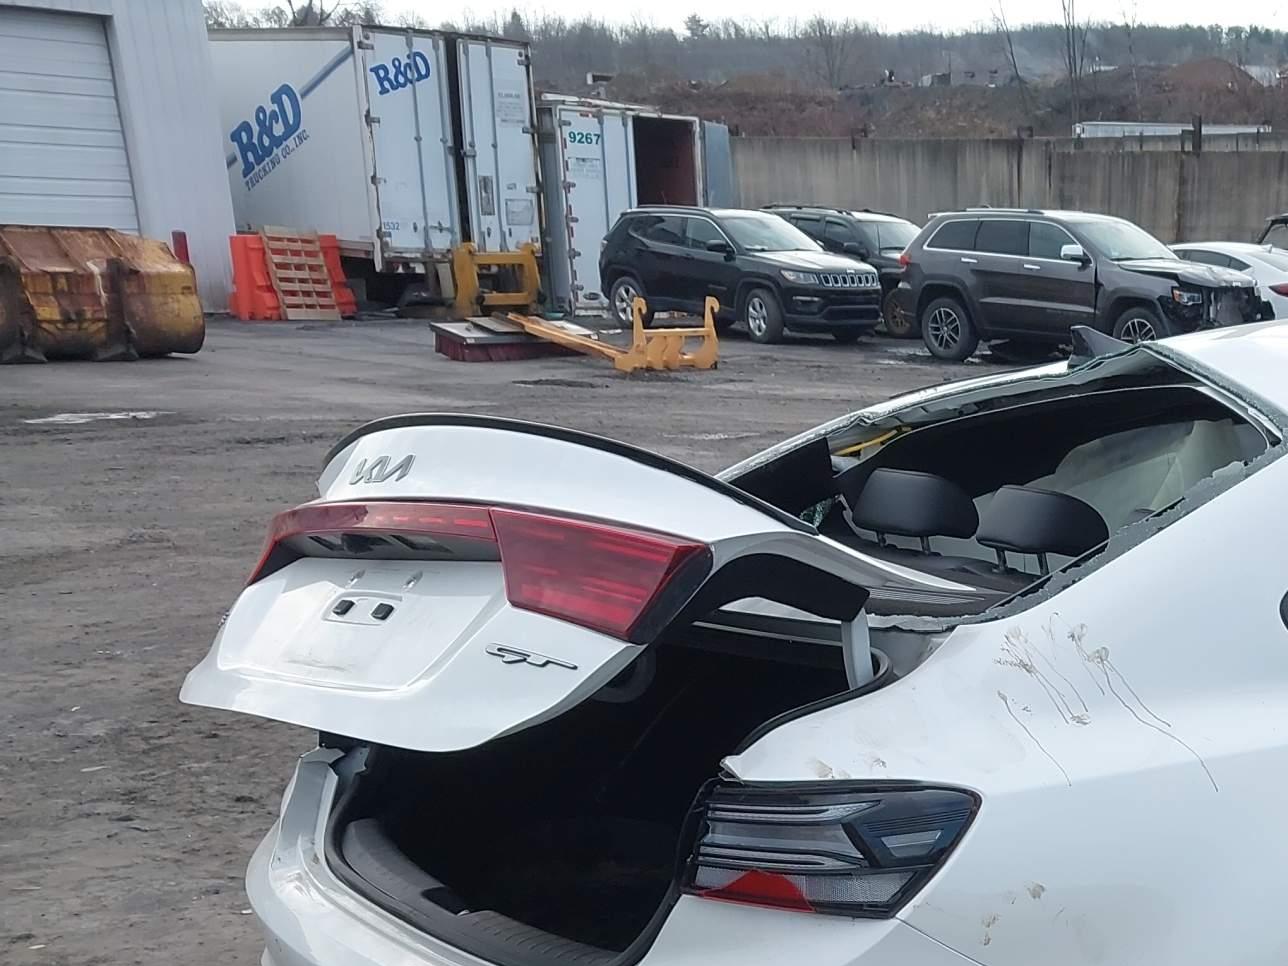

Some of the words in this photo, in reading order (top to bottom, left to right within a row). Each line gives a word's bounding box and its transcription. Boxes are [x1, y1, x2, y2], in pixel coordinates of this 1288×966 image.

[369, 51, 431, 95] R&D
[230, 83, 302, 178] R&D
[568, 131, 601, 145] 9267
[245, 153, 281, 192] TRUCKING
[485, 642, 578, 670] GT
